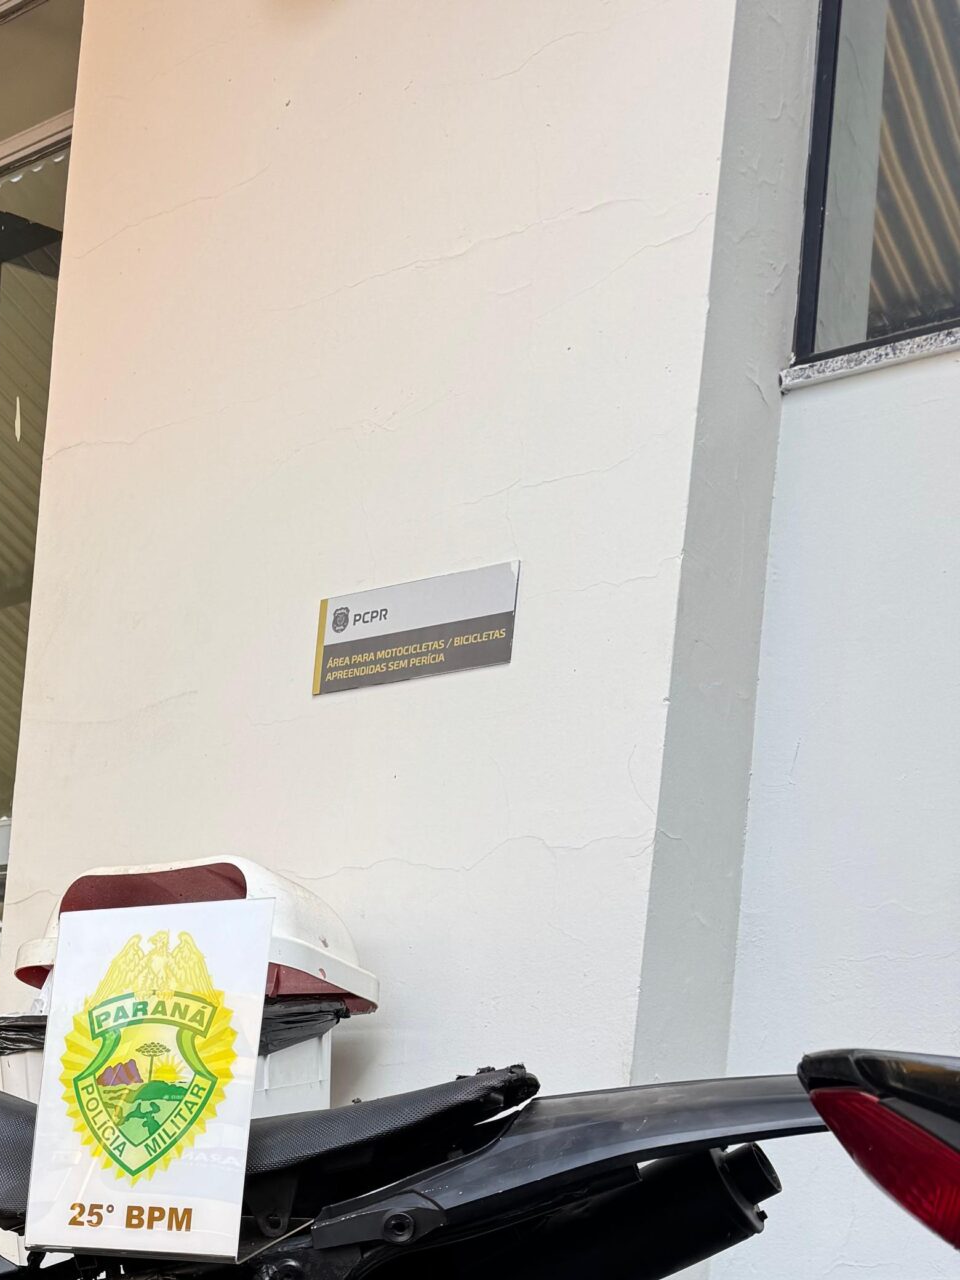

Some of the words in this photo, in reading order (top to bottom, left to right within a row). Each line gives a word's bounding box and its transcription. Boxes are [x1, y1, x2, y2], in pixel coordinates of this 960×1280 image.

[352, 608, 388, 626] PCPR
[326, 656, 350, 669] ÁREA
[351, 653, 375, 666] PARA
[376, 639, 445, 661] MOTOCICLETAS
[446, 637, 453, 649] /
[453, 628, 507, 646] BICICLETAS
[325, 664, 387, 682] APREENDIDAS
[387, 659, 409, 672] SEM
[409, 652, 445, 669] PERÍCIA
[94, 1000, 208, 1031] PARANÁ
[80, 1084, 125, 1159] POLÍCIA
[143, 1083, 206, 1158] MILITAR
[125, 1205, 193, 1232] BPM
